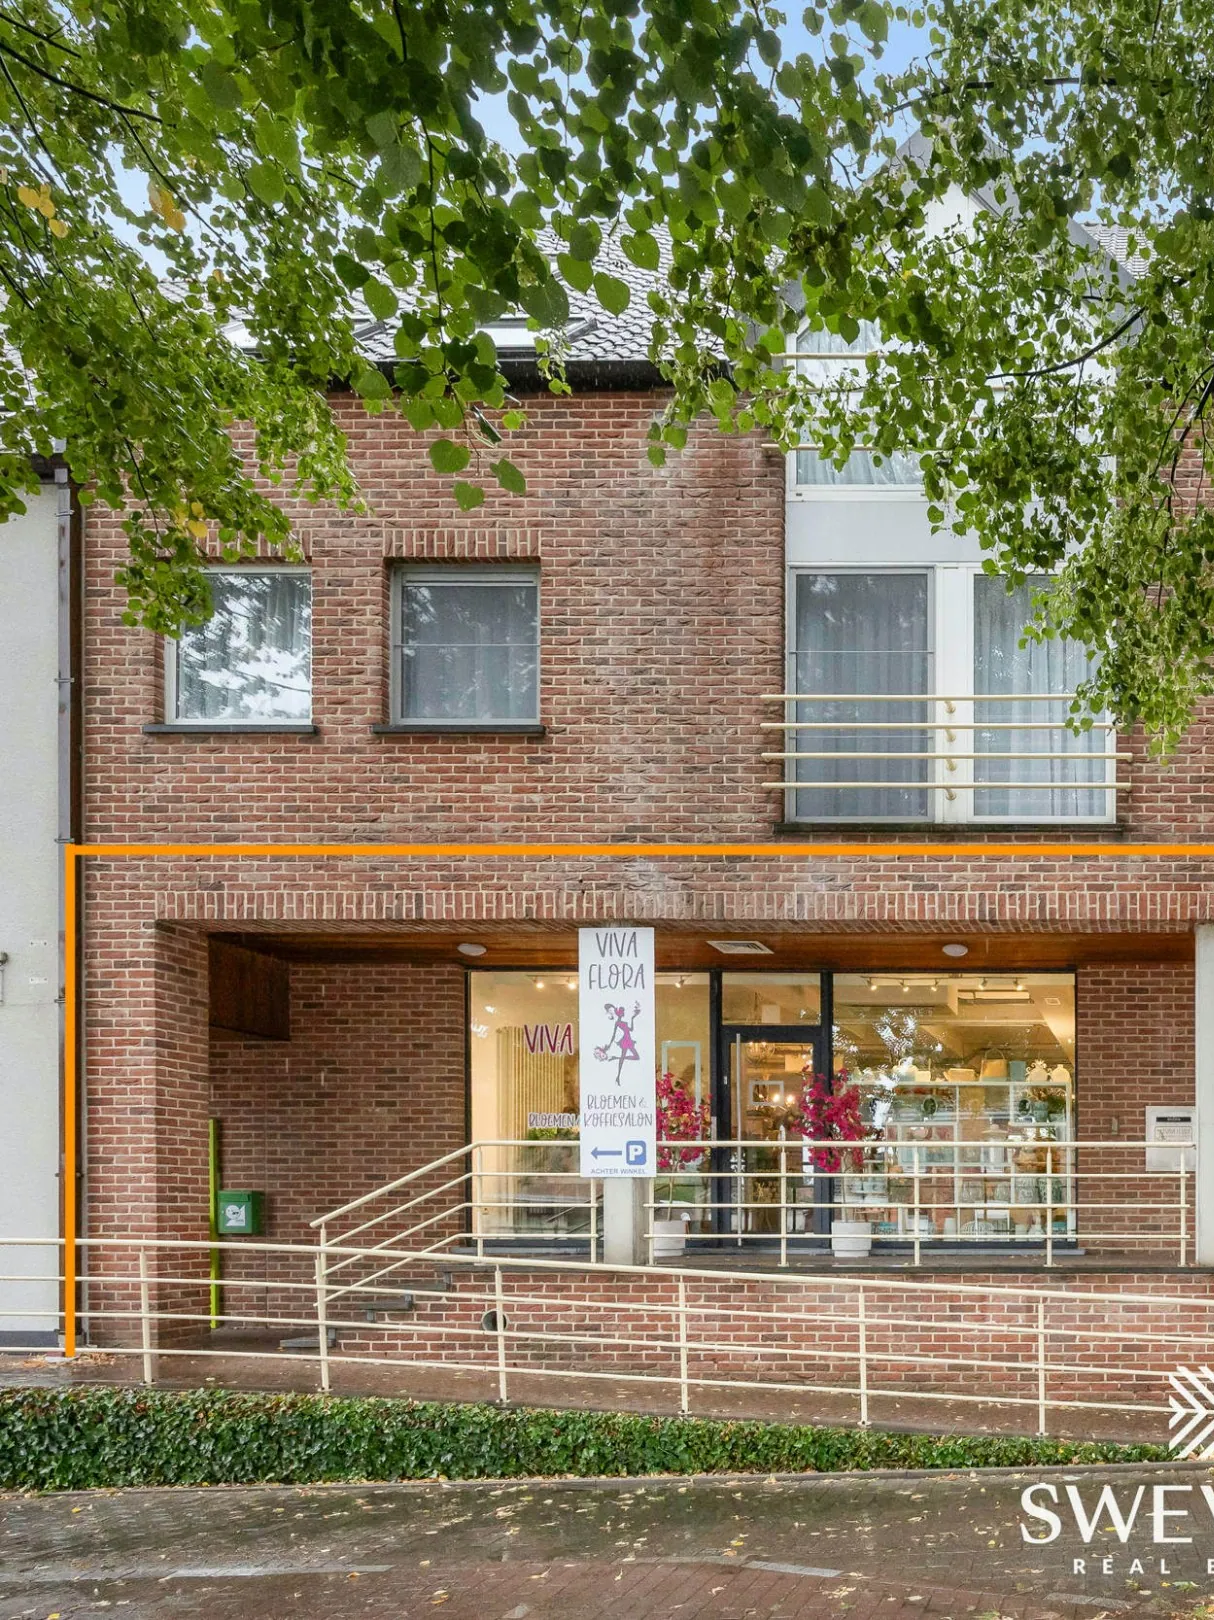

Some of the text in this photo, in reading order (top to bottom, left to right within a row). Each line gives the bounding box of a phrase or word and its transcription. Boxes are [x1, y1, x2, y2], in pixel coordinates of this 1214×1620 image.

[595, 931, 638, 958] VIVA
[588, 963, 645, 990] FLORA
[523, 1023, 573, 1054] VIVA
[587, 1094, 637, 1110] BLOEMEN
[528, 1112, 575, 1128] BLOEMEN
[583, 1112, 653, 1128] KOFFIESALON
